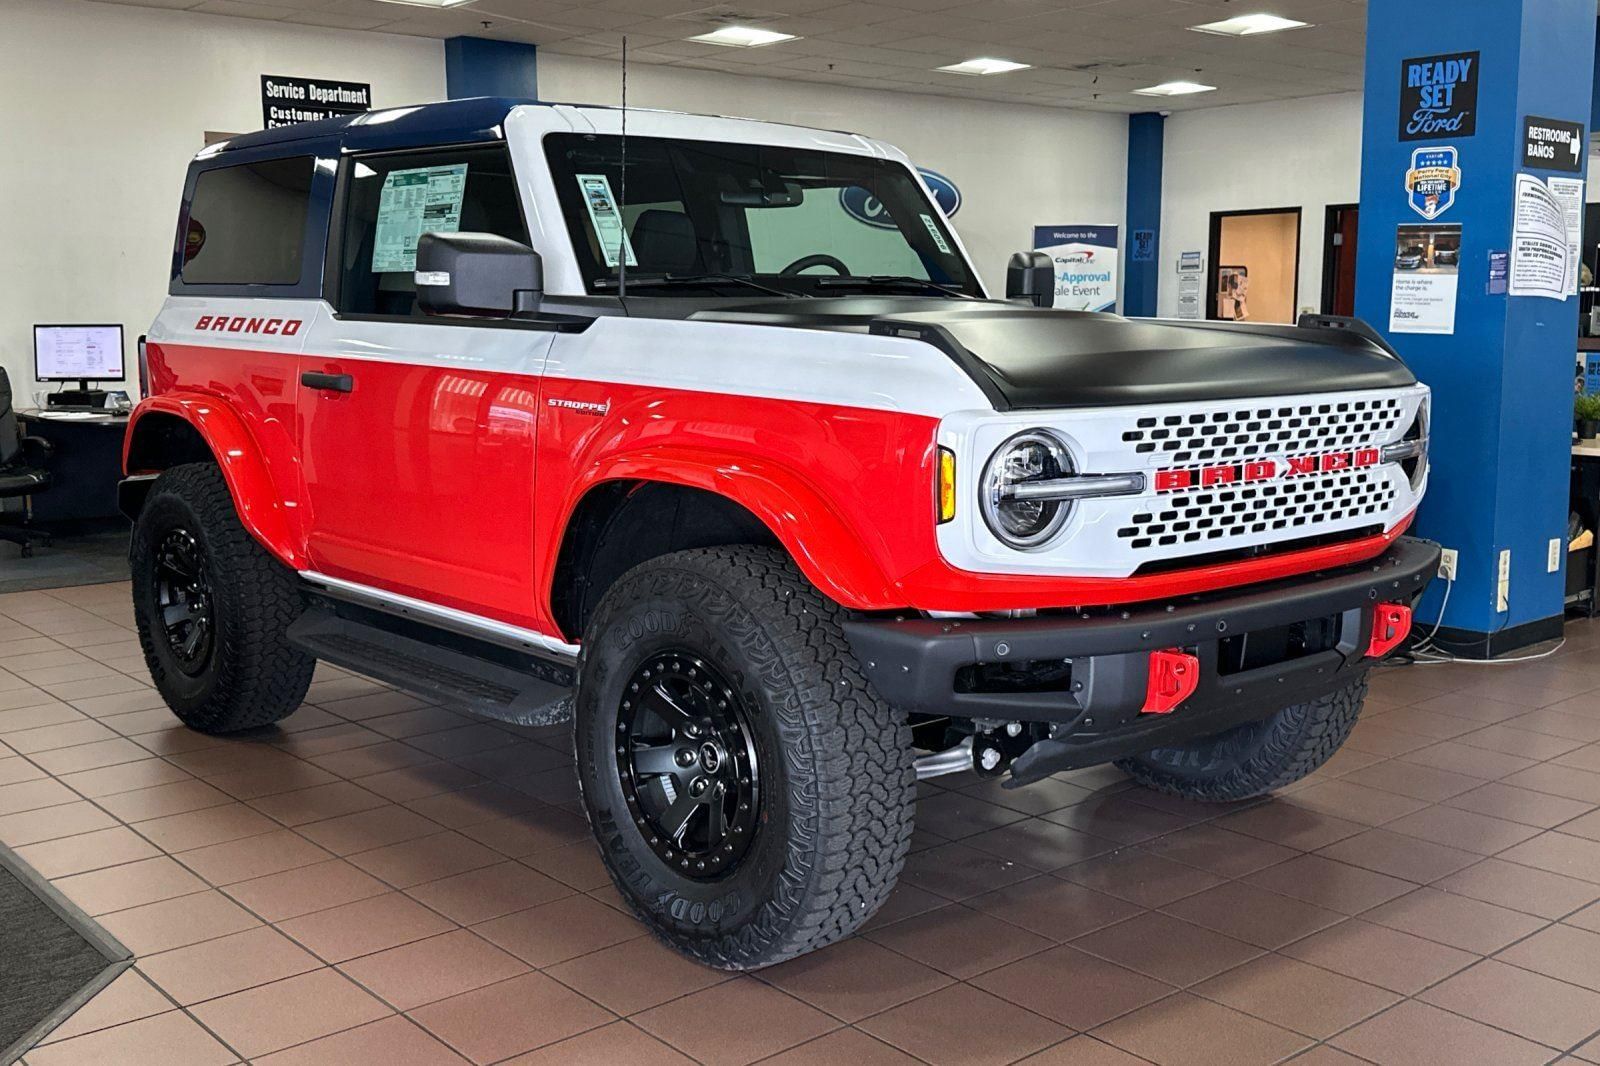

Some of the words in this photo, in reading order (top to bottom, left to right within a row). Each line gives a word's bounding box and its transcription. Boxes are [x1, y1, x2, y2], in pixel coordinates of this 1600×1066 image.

[1408, 58, 1472, 88] READY
[266, 81, 305, 99] Service
[309, 84, 367, 104] Department
[1420, 83, 1456, 108] SET
[270, 106, 324, 121] Customer
[1407, 108, 1464, 135] Ford
[1528, 126, 1571, 143] RESTROOMS
[1527, 142, 1555, 159] BAÑOS
[1417, 183, 1447, 192] LIFETIME
[1055, 271, 1111, 285] -Approval
[1055, 285, 1070, 296] ale
[1073, 286, 1101, 296] Event
[195, 316, 302, 336] BRONCO
[548, 398, 607, 411] STROPPE
[575, 409, 605, 417] EDITION
[1154, 448, 1379, 491] BRONCO
